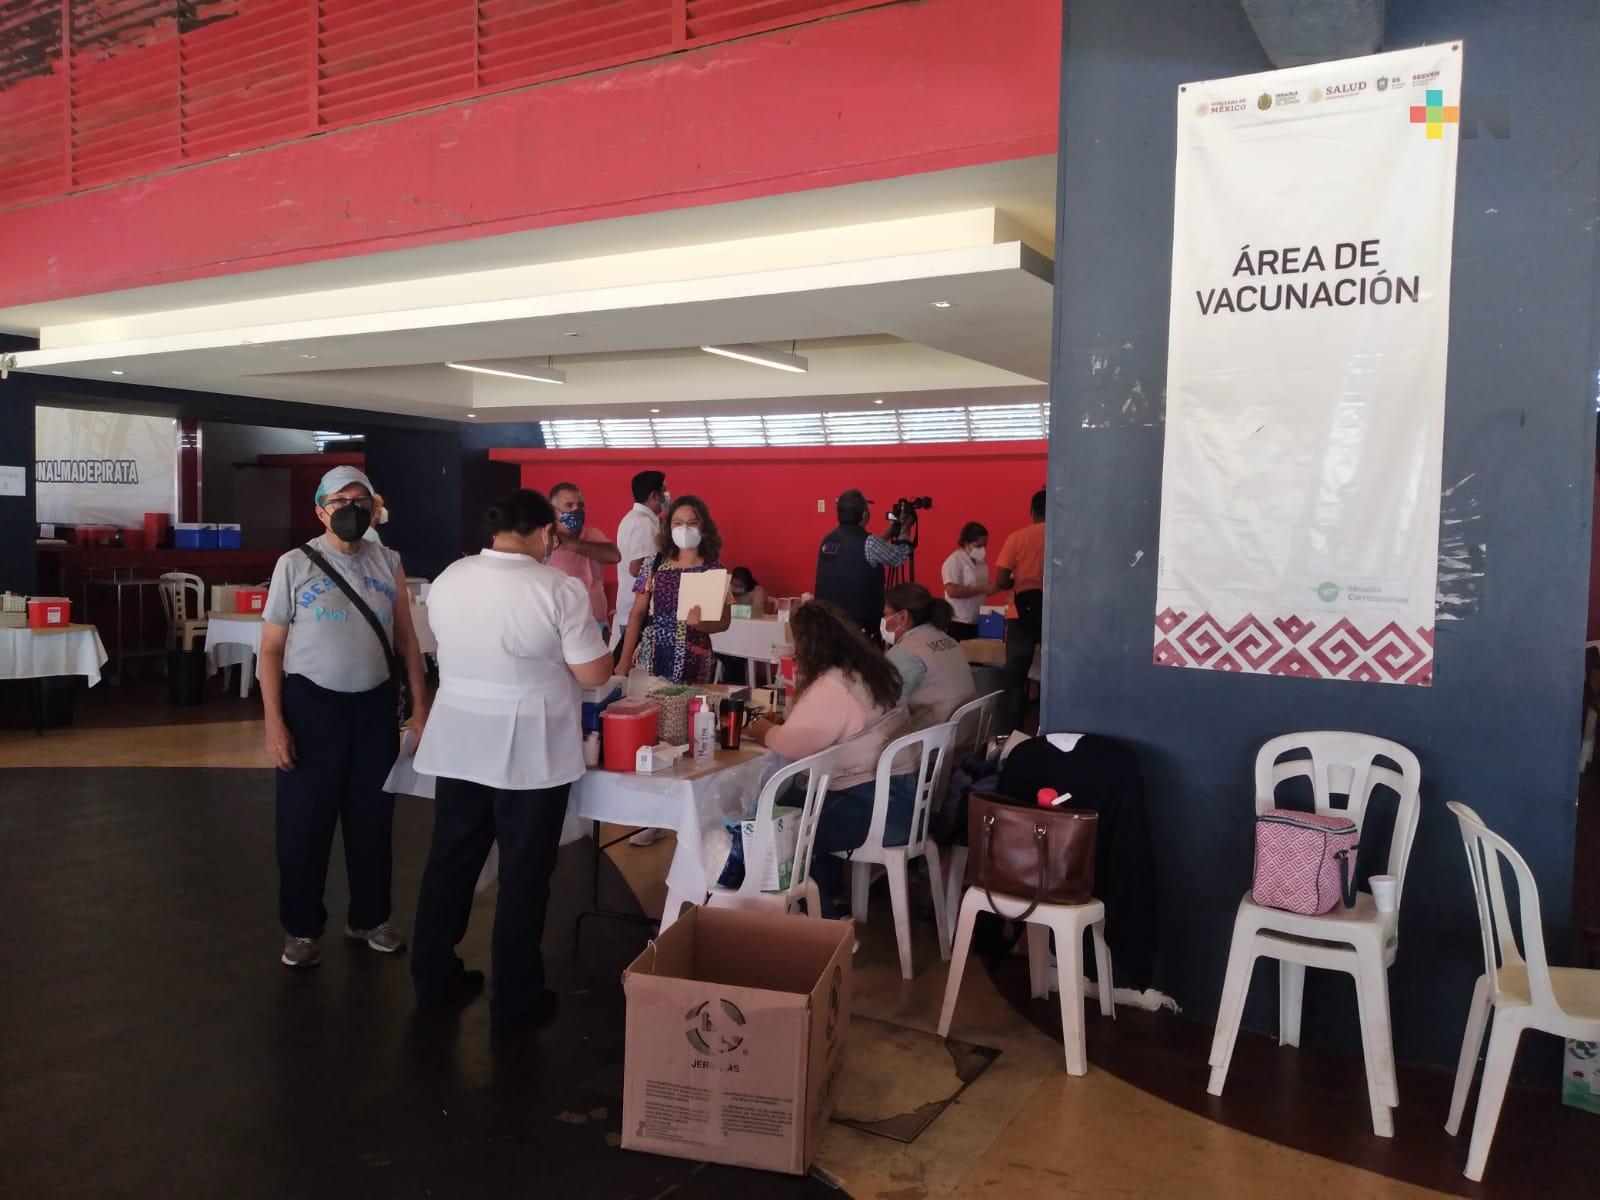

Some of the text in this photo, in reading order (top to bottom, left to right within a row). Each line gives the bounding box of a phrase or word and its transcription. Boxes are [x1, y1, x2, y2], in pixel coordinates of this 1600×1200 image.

[1326, 81, 1367, 96] SALUD
[1210, 103, 1247, 114] MÉXICO
[1232, 239, 1380, 277] ÁREA DE
[1196, 269, 1420, 316] VACUNACIÓN
[690, 1058, 740, 1073] JERAS
